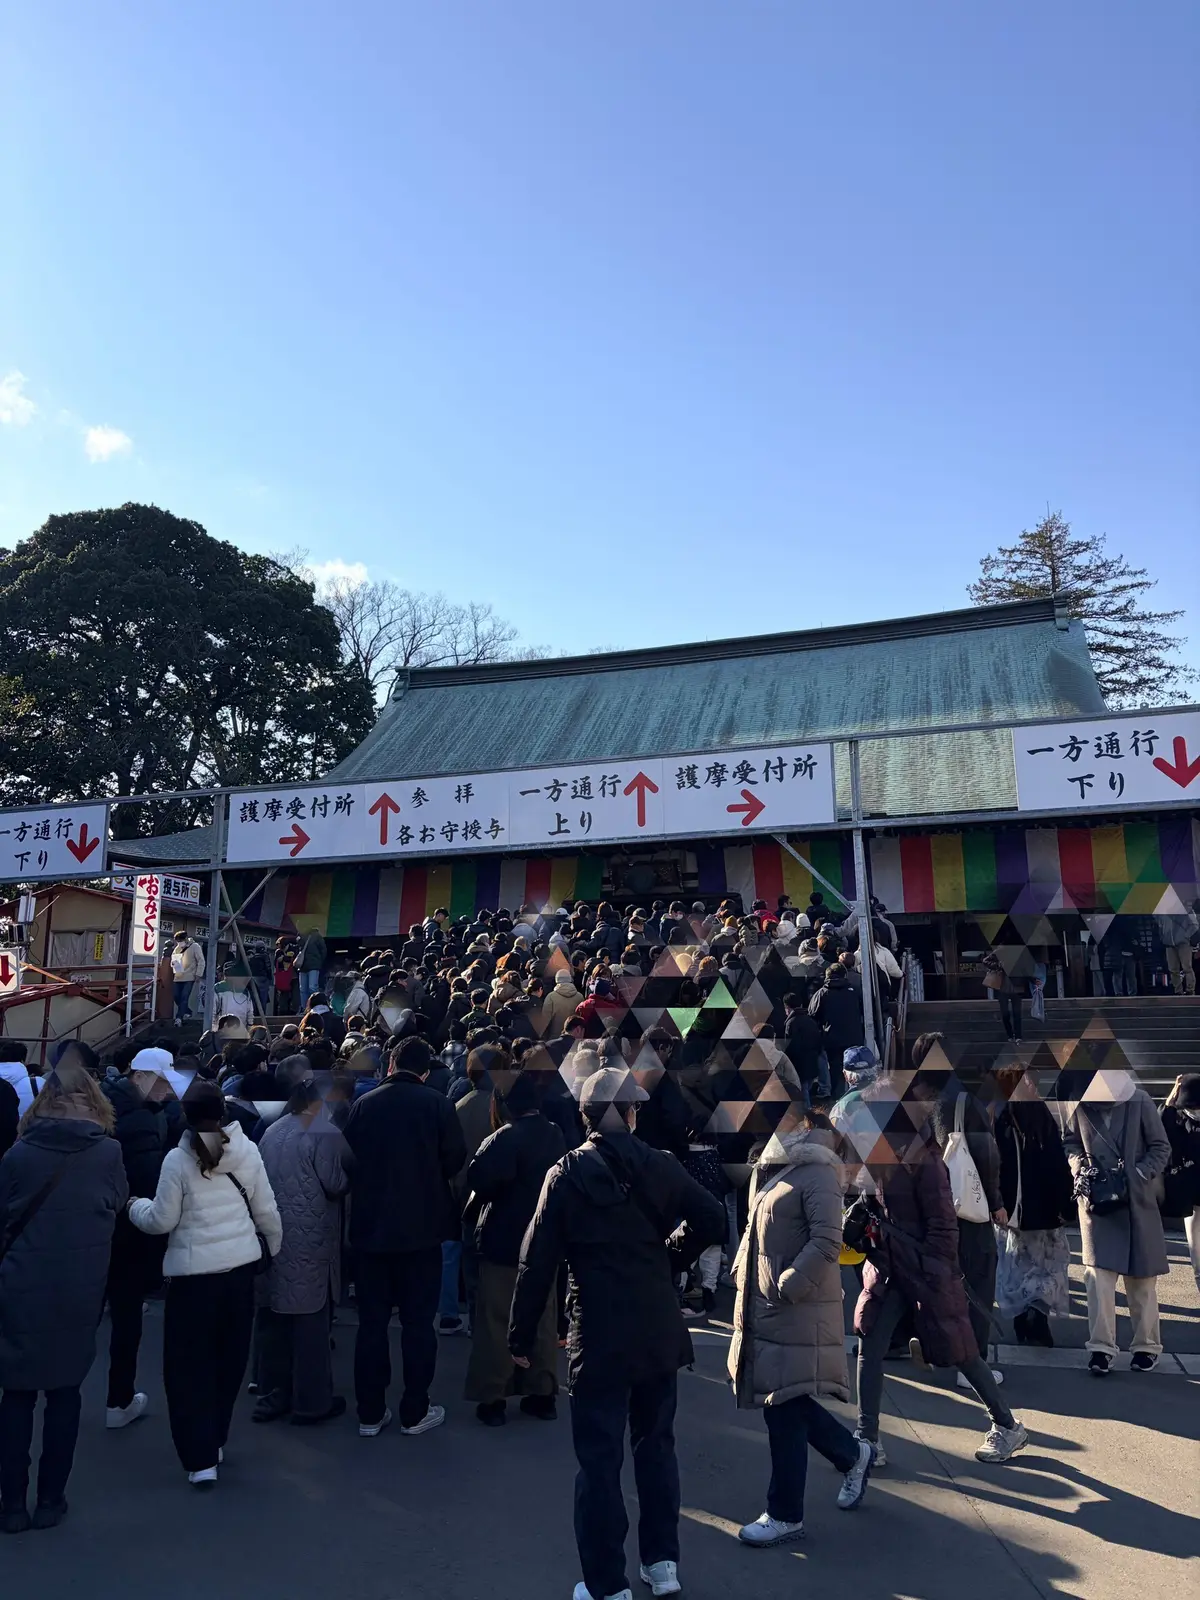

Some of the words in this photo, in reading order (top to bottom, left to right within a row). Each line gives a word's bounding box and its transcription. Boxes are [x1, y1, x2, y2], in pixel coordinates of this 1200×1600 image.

[1027, 730, 1160, 762] 一方通行
[674, 753, 818, 790] 護摩受付所
[1067, 771, 1125, 799] 下り
[519, 773, 622, 803] 一方通行
[239, 793, 355, 824] 護摩受付所
[548, 809, 593, 836] 上り
[0, 818, 73, 842] 一方通行
[396, 817, 505, 846] 各お守授与
[14, 850, 48, 871] 下り
[143, 874, 159, 952] おみくじ
